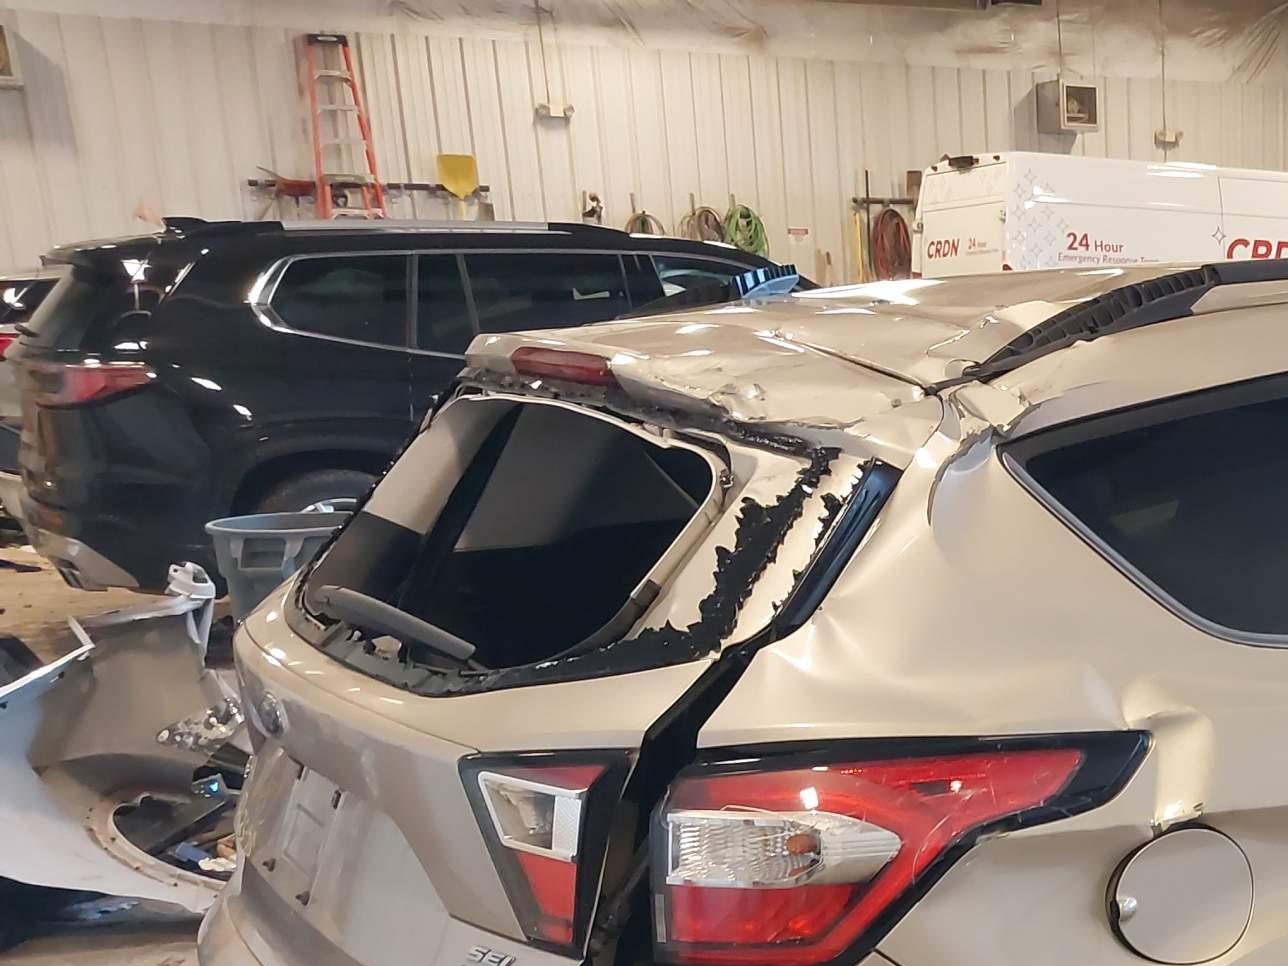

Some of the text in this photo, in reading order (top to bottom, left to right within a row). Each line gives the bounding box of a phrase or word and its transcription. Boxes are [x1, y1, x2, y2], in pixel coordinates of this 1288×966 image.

[927, 239, 960, 259] CRDN
[1066, 232, 1124, 253] 24 Hour
[1057, 252, 1100, 265] Emergency
